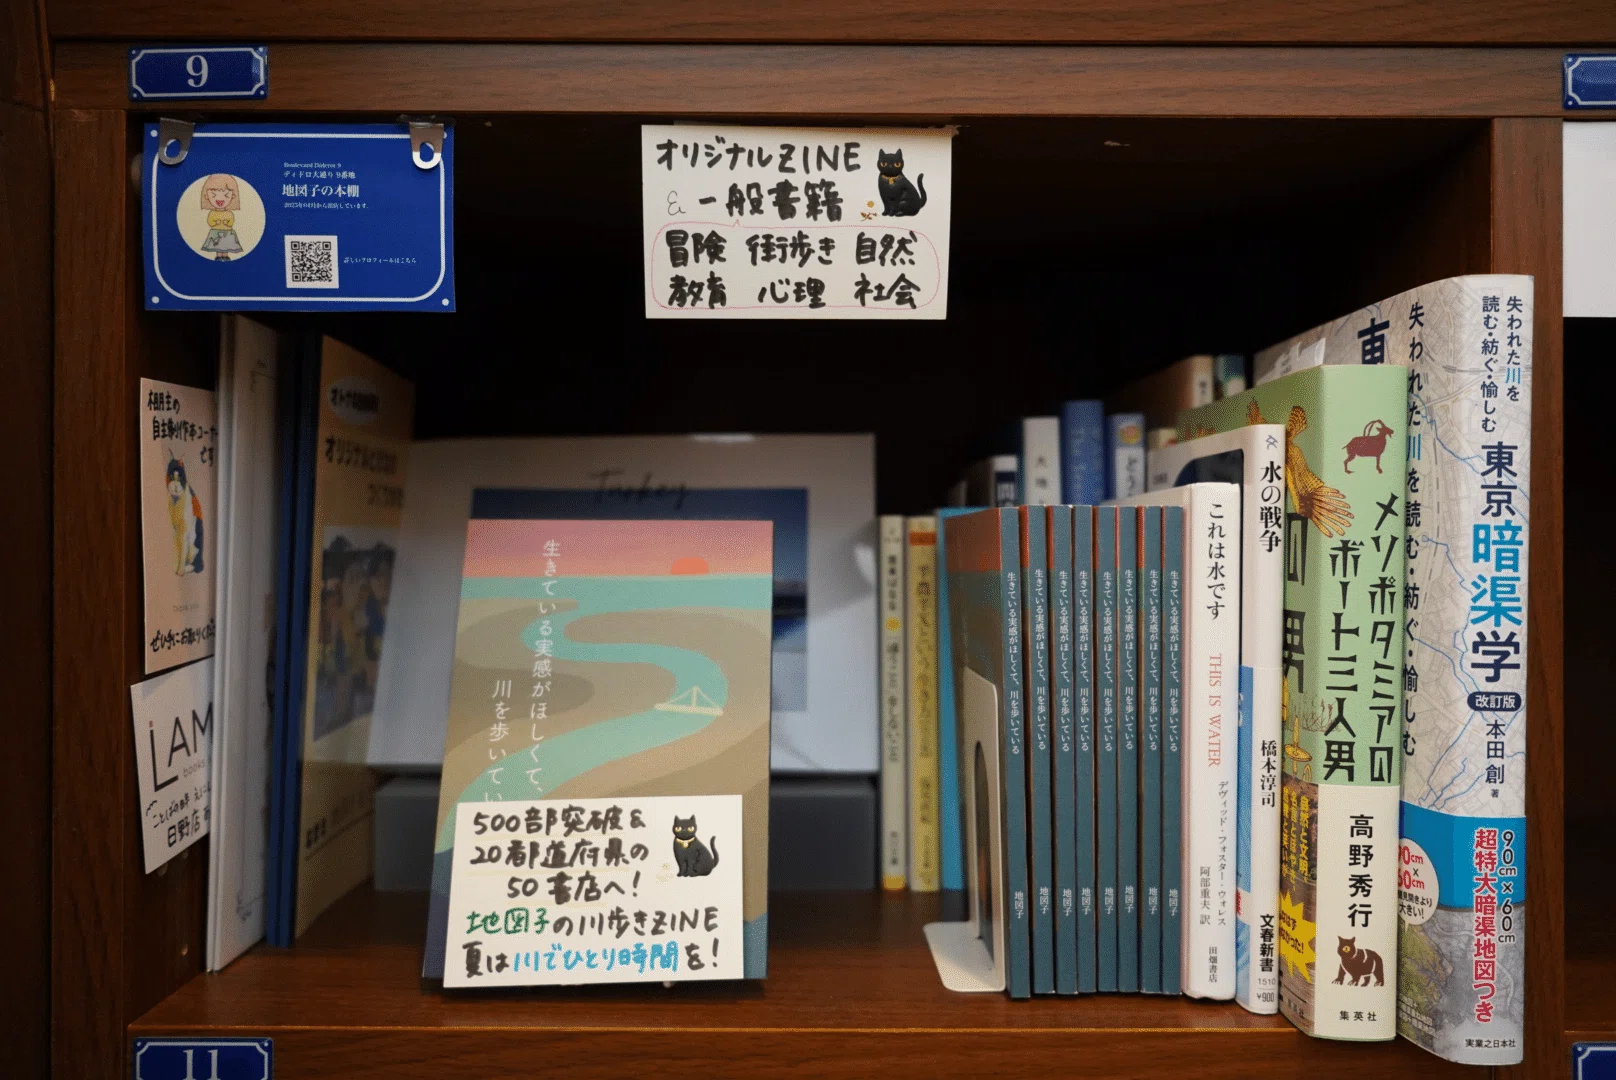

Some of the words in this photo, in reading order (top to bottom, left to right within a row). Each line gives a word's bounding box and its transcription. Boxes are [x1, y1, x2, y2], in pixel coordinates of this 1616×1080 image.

[186, 55, 208, 87] 9
[656, 135, 861, 174] オリジナルZINE
[282, 184, 360, 197] 地図子の本棚
[698, 178, 844, 222] 一般書籍
[665, 229, 727, 268] 冒険
[745, 230, 836, 268] 街歩き
[855, 230, 918, 267] 自然
[668, 271, 727, 310] 教育
[757, 277, 826, 309] 心理
[854, 272, 921, 309] 社会
[1505, 295, 1524, 402] 失われた川を
[1259, 460, 1283, 553] 水の戦争
[1206, 503, 1226, 620] これは水です
[1470, 441, 1525, 683] 東京暗渠学
[1368, 492, 1400, 784] メソポタミアの
[1208, 653, 1222, 687] THIS
[1208, 695, 1222, 707] IS
[1475, 694, 1516, 709] 改訂版
[1207, 715, 1222, 768] WATER
[1260, 740, 1277, 808] 橋本淳司
[470, 837, 649, 869] 20都道府県の
[1348, 813, 1374, 928] 高野秀行
[1014, 891, 1025, 919] 地図子
[1039, 886, 1049, 915] 地図子
[1062, 888, 1072, 917] 地図子
[1082, 887, 1091, 915] 地図子
[1105, 887, 1114, 915] 地図子
[1125, 885, 1134, 914] 地図子
[1149, 887, 1158, 915] 地図子
[1169, 889, 1179, 917] 地図子
[1473, 827, 1497, 1023] 超特大暗渠地図つき
[1260, 914, 1275, 972] 文春新書
[1339, 1009, 1377, 1022] 集英社
[1465, 1038, 1516, 1049] 実業之日本社
